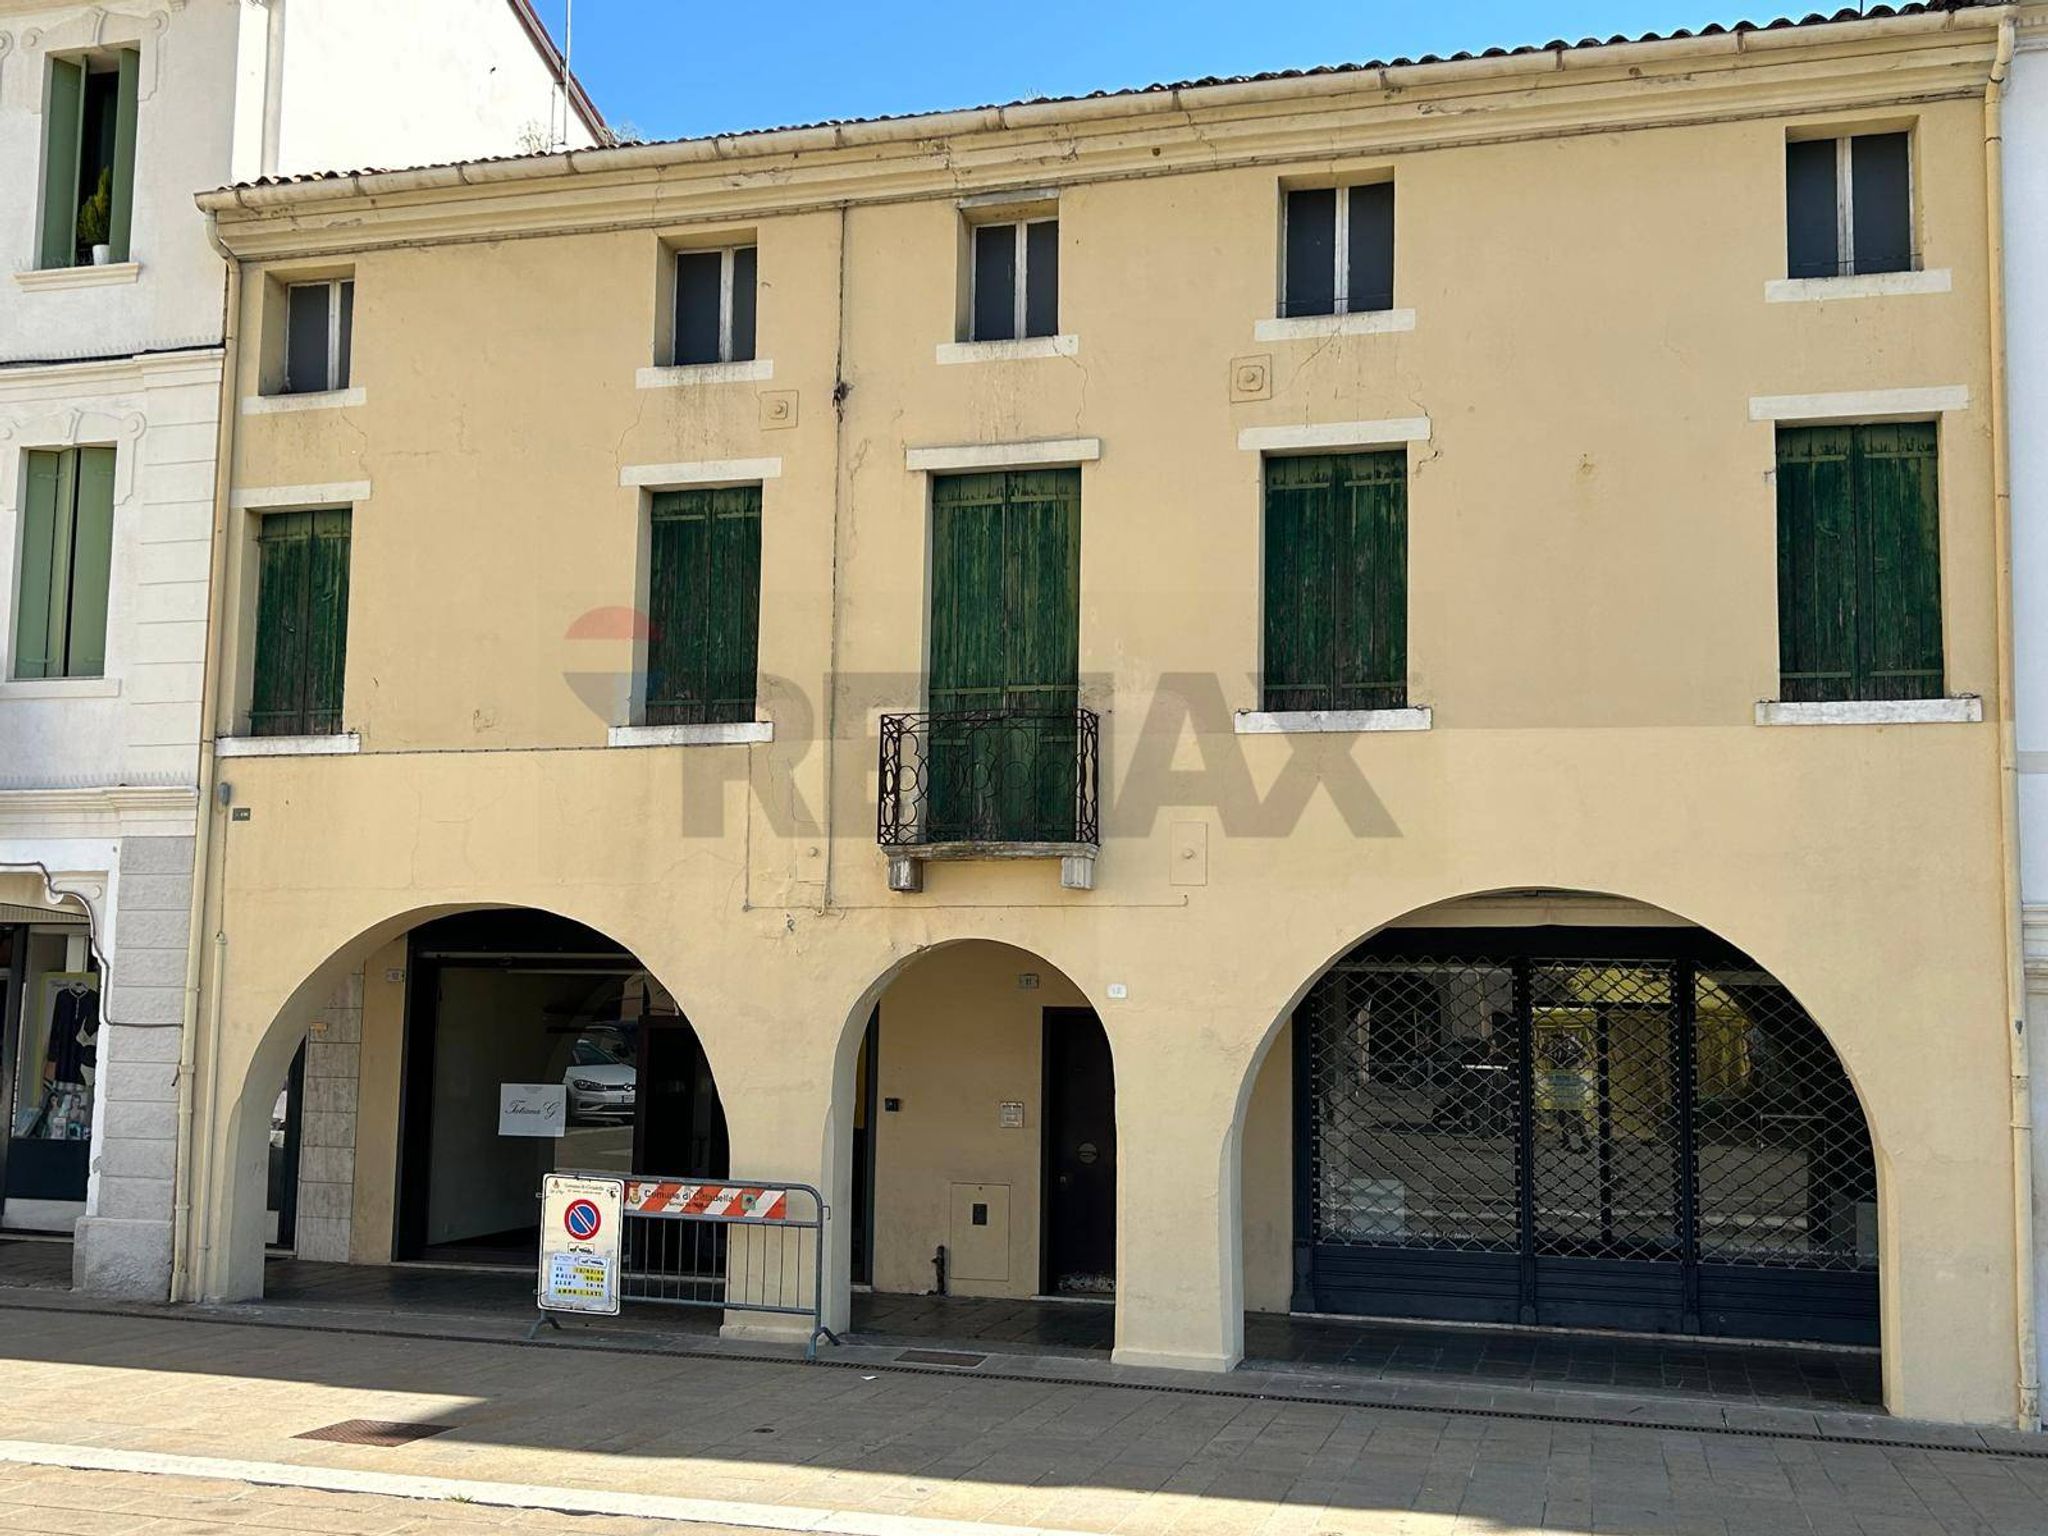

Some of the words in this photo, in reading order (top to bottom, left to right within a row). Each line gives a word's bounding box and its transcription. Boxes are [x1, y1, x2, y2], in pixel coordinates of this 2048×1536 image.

[543, 1101, 561, 1121] G
[644, 1189, 680, 1201] Comune
[682, 1191, 691, 1201] di
[693, 1191, 734, 1204] Cittadella
